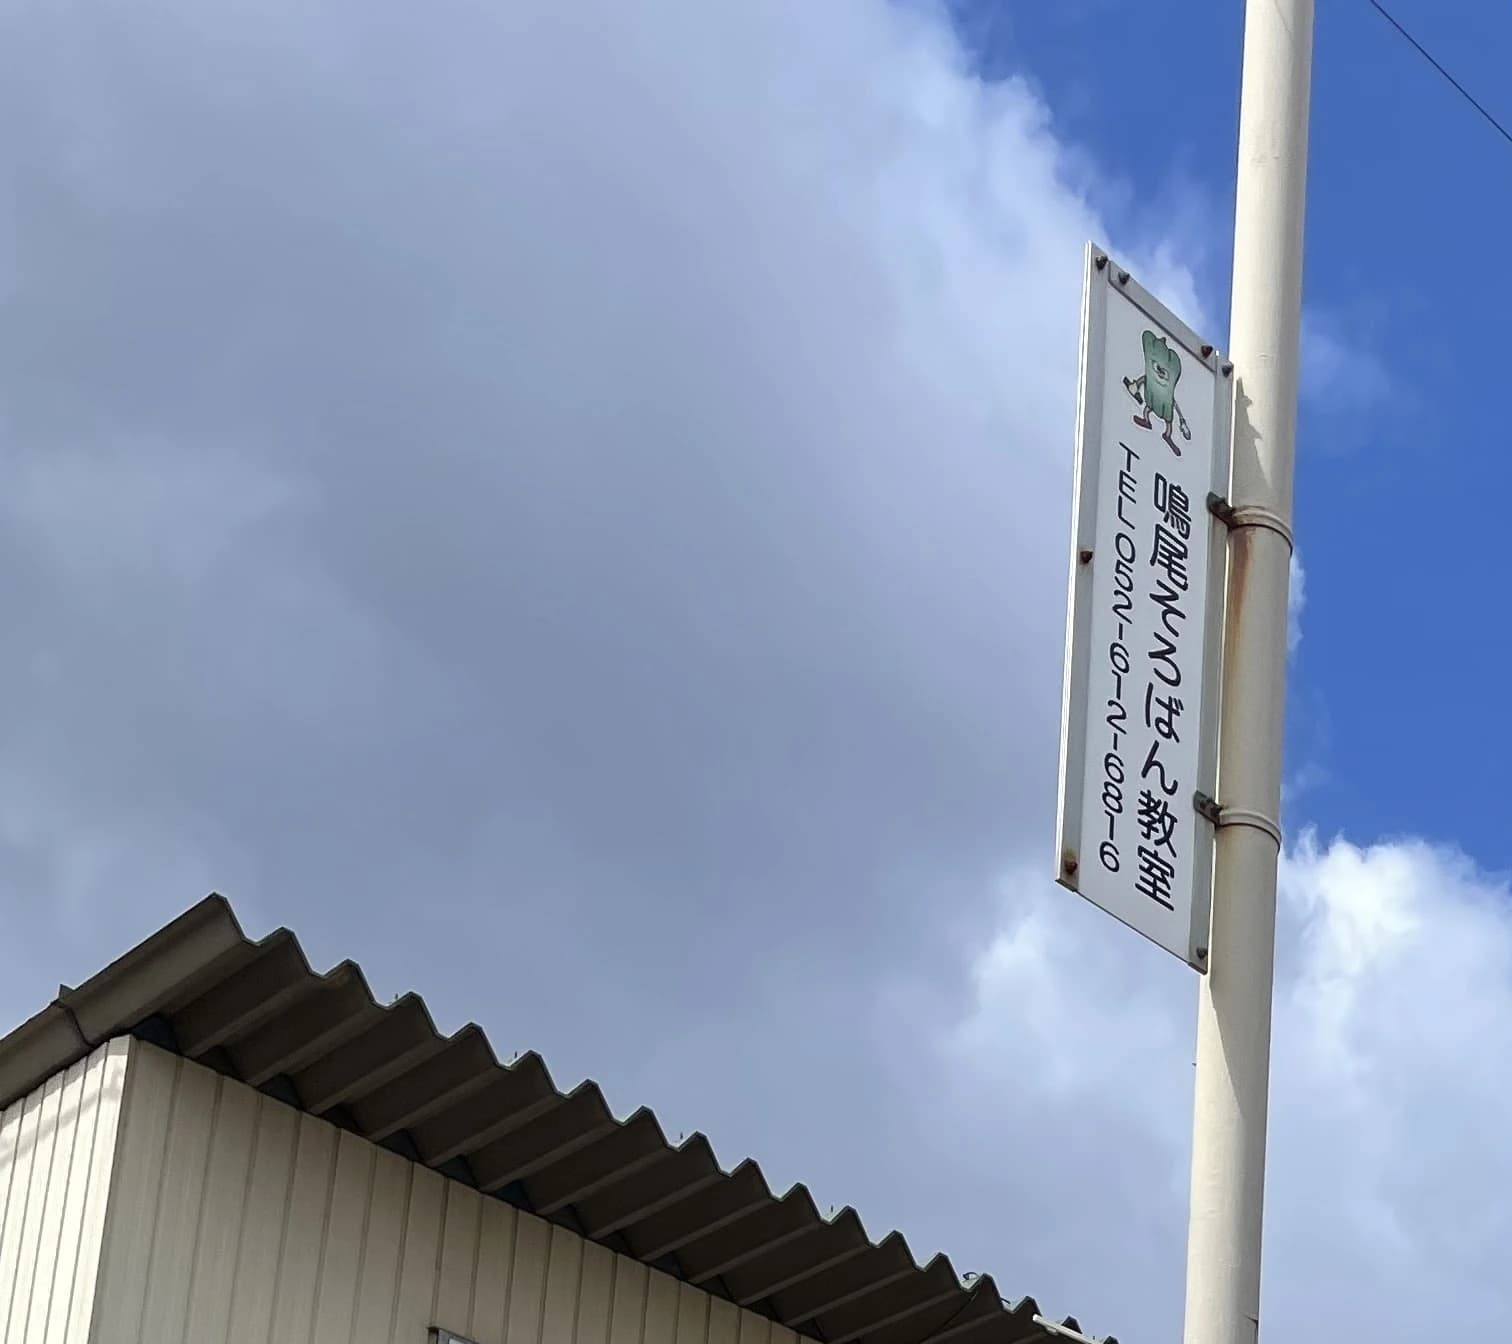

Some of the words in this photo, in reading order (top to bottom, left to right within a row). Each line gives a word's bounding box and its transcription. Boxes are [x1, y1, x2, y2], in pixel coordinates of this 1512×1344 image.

[1135, 472, 1192, 912] 鳴尾そろばん教室
